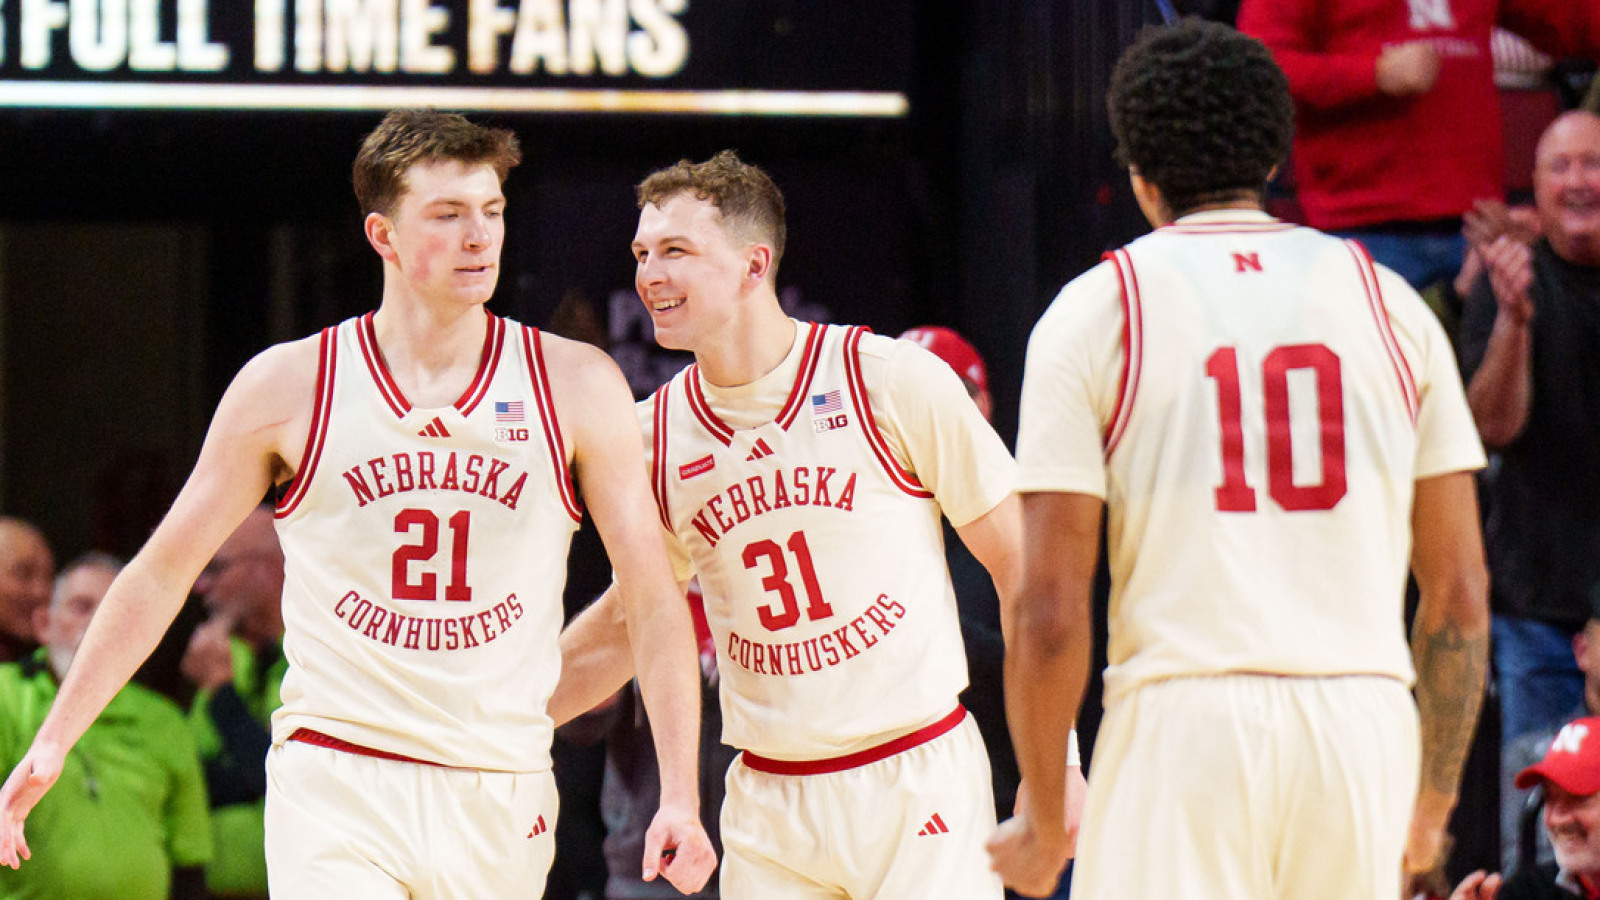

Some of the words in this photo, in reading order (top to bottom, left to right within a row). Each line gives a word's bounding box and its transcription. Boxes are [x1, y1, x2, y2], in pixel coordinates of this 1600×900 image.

[20, 0, 230, 71] FULL
[467, 0, 690, 77] FANS
[1232, 253, 1264, 273] N
[1205, 343, 1348, 513] 10
[342, 451, 529, 510] NEBRASKA
[690, 466, 857, 548] NEBRASKA
[391, 508, 473, 602] 21
[741, 530, 835, 632] 31
[334, 590, 525, 651] CORNHUSKERS
[727, 593, 907, 676] CORNHUSKERS
[1551, 723, 1588, 755] N
